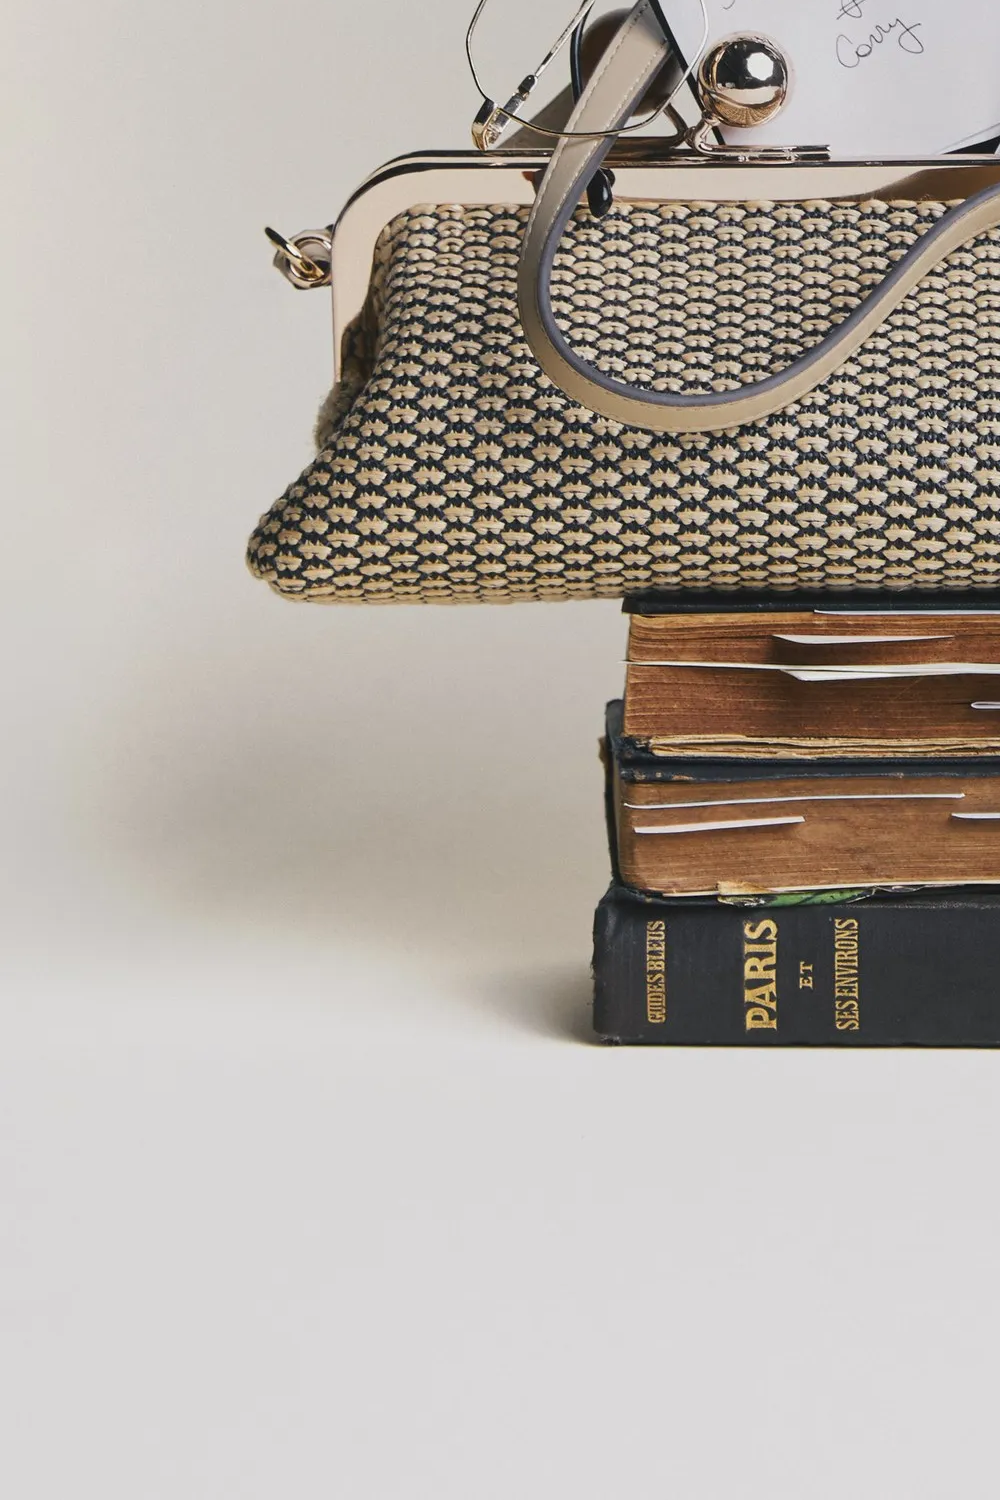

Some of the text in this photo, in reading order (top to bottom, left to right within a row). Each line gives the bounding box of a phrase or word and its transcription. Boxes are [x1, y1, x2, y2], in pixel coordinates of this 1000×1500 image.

[646, 919, 666, 972] BLEUS
[743, 918, 779, 1031] PARIS
[799, 960, 814, 990] ET
[833, 917, 860, 1031] SES ENVIRONS
